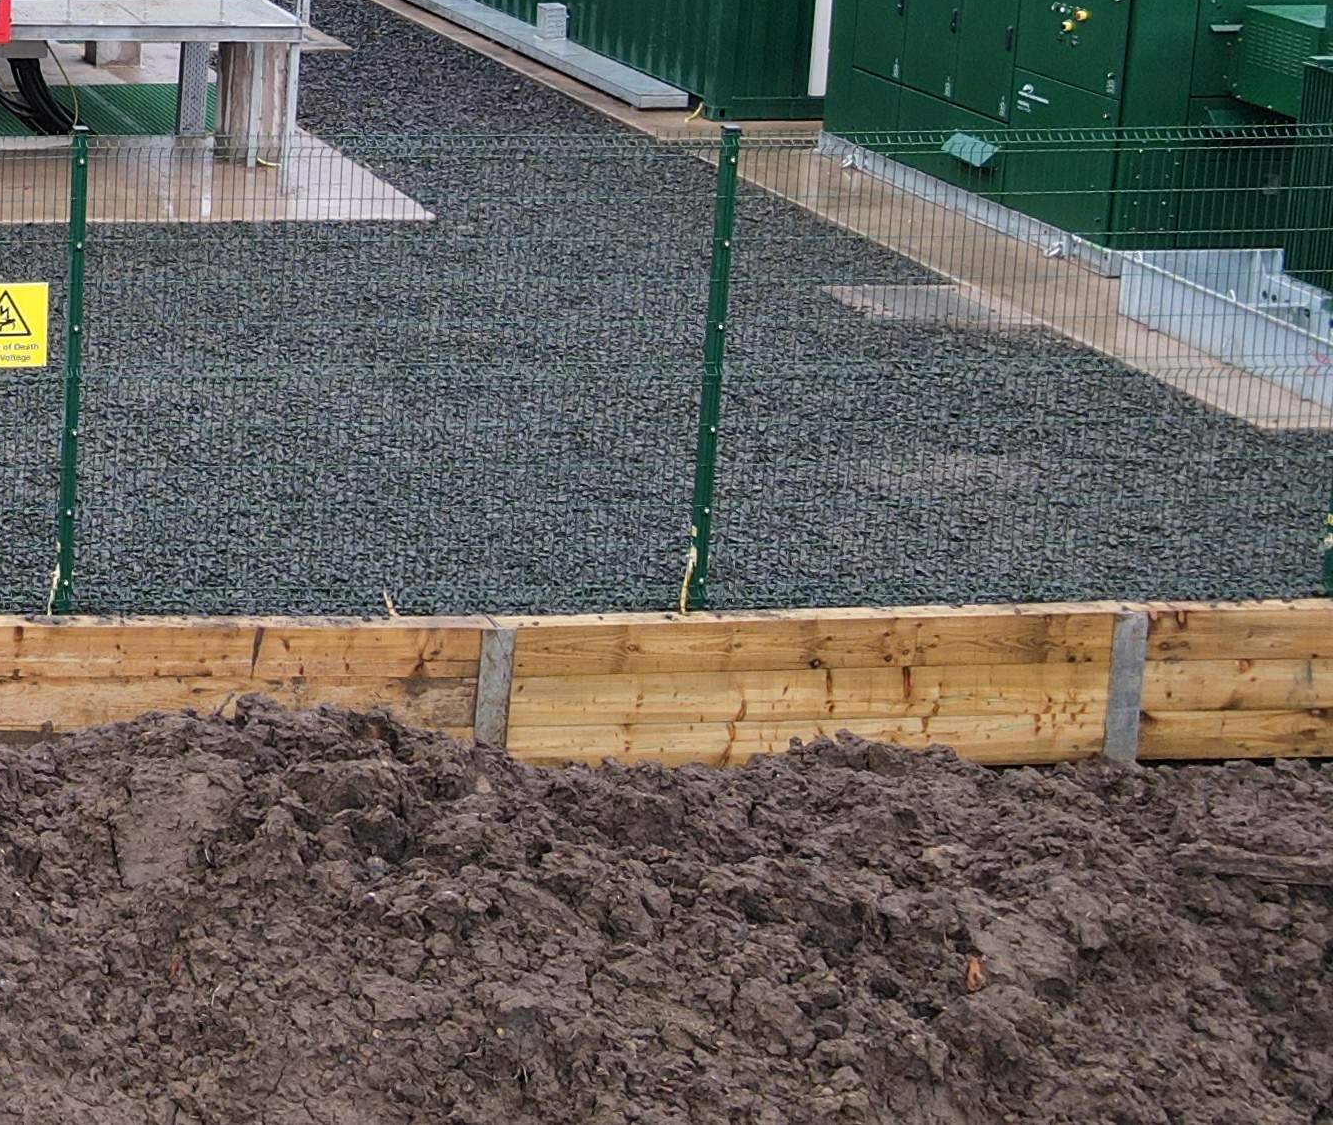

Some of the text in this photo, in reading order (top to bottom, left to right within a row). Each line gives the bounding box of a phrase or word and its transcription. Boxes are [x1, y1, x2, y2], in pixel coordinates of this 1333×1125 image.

[2, 343, 12, 351] of
[14, 343, 39, 351] Death
[0, 354, 31, 363] Voltage
